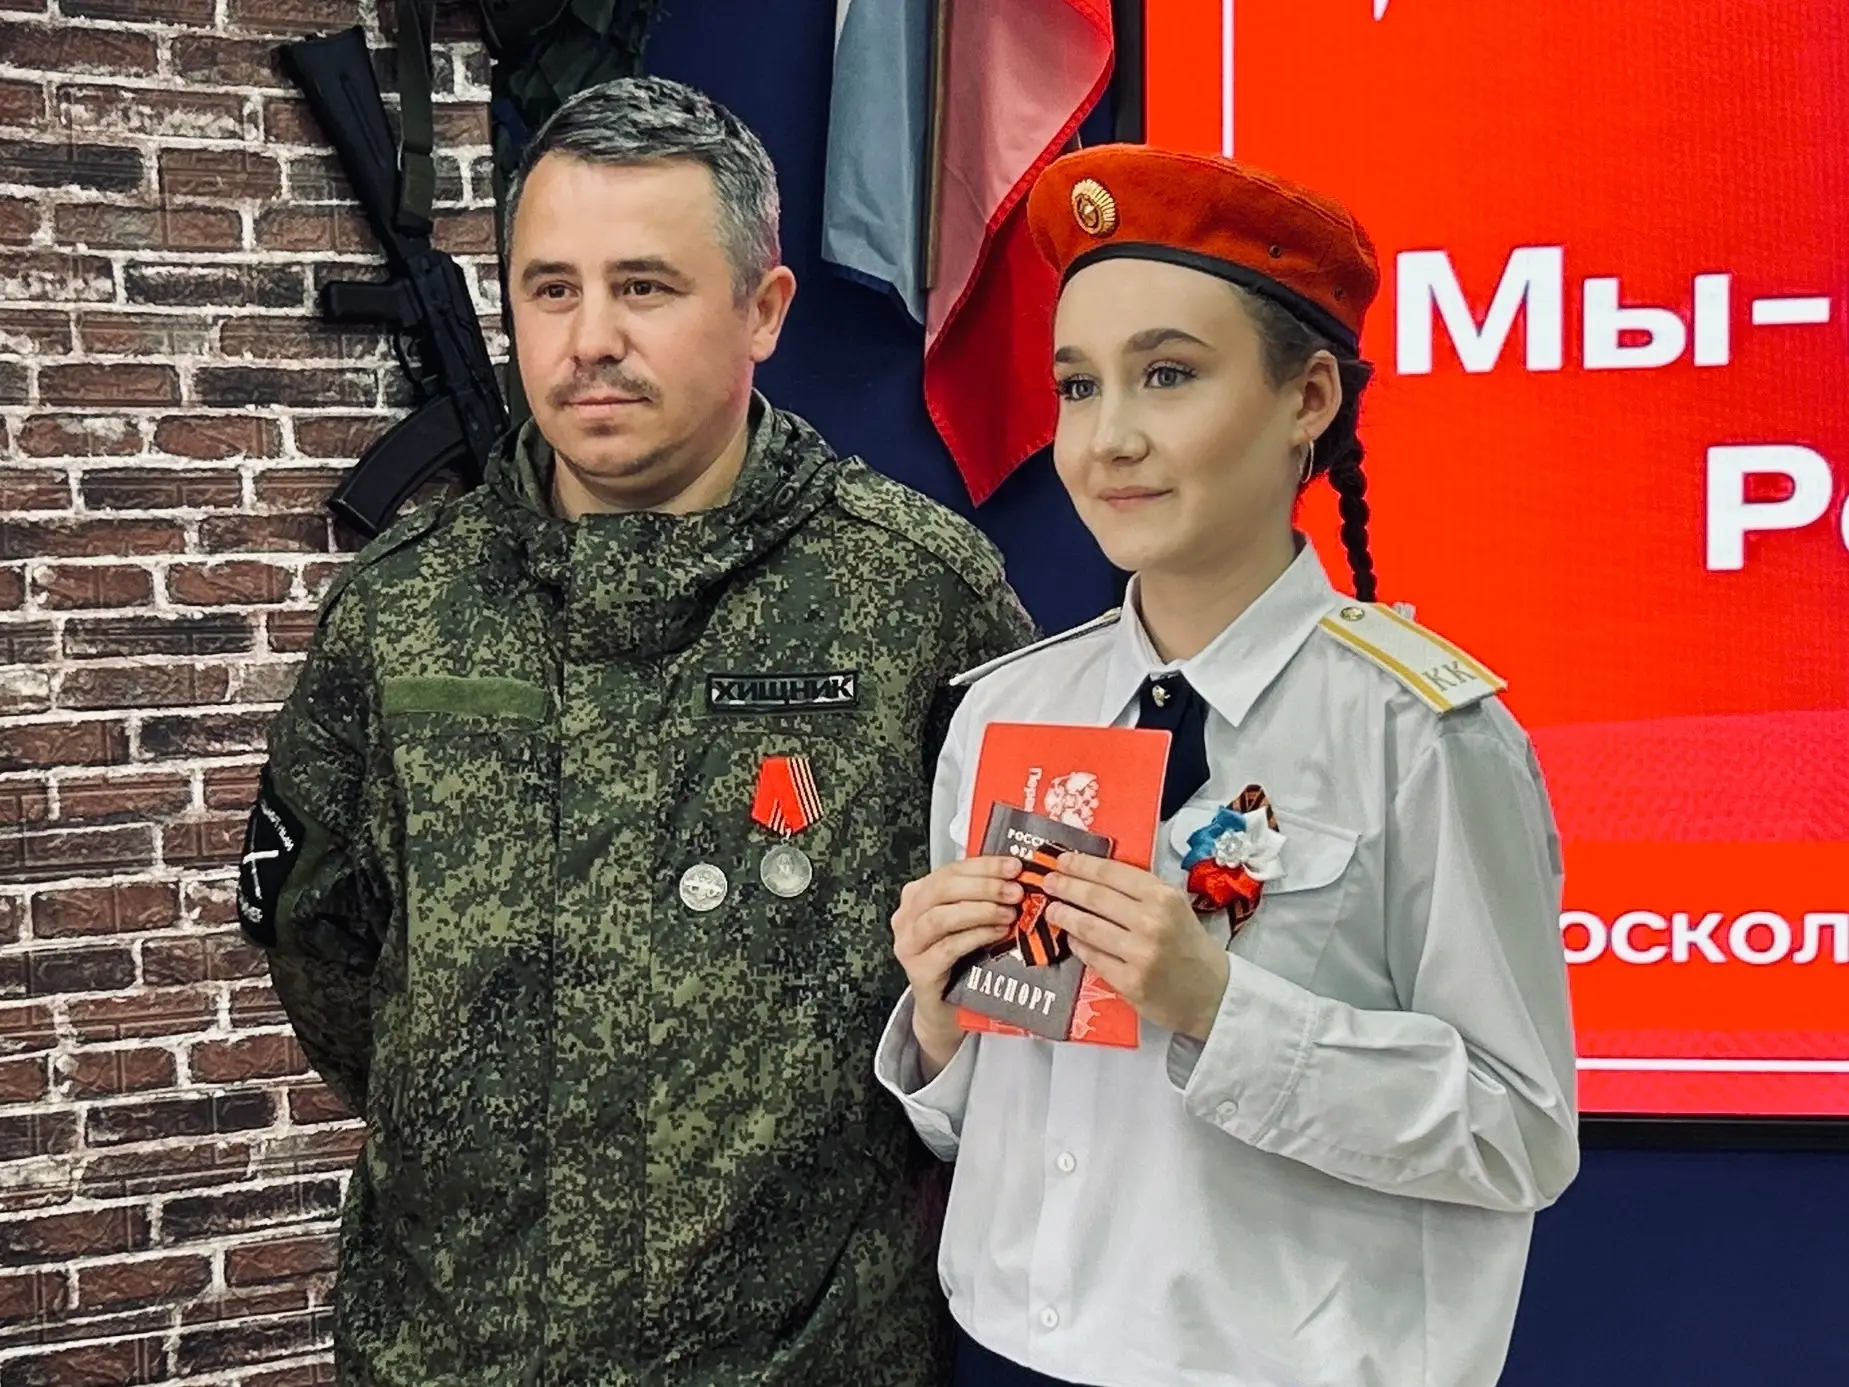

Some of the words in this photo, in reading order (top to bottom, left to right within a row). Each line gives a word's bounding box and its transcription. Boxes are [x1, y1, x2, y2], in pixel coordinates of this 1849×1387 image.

[1707, 445, 1849, 571] Р
[714, 679, 853, 704] ХИЩНИК
[967, 965, 1056, 1016] ПАСПОРТ
